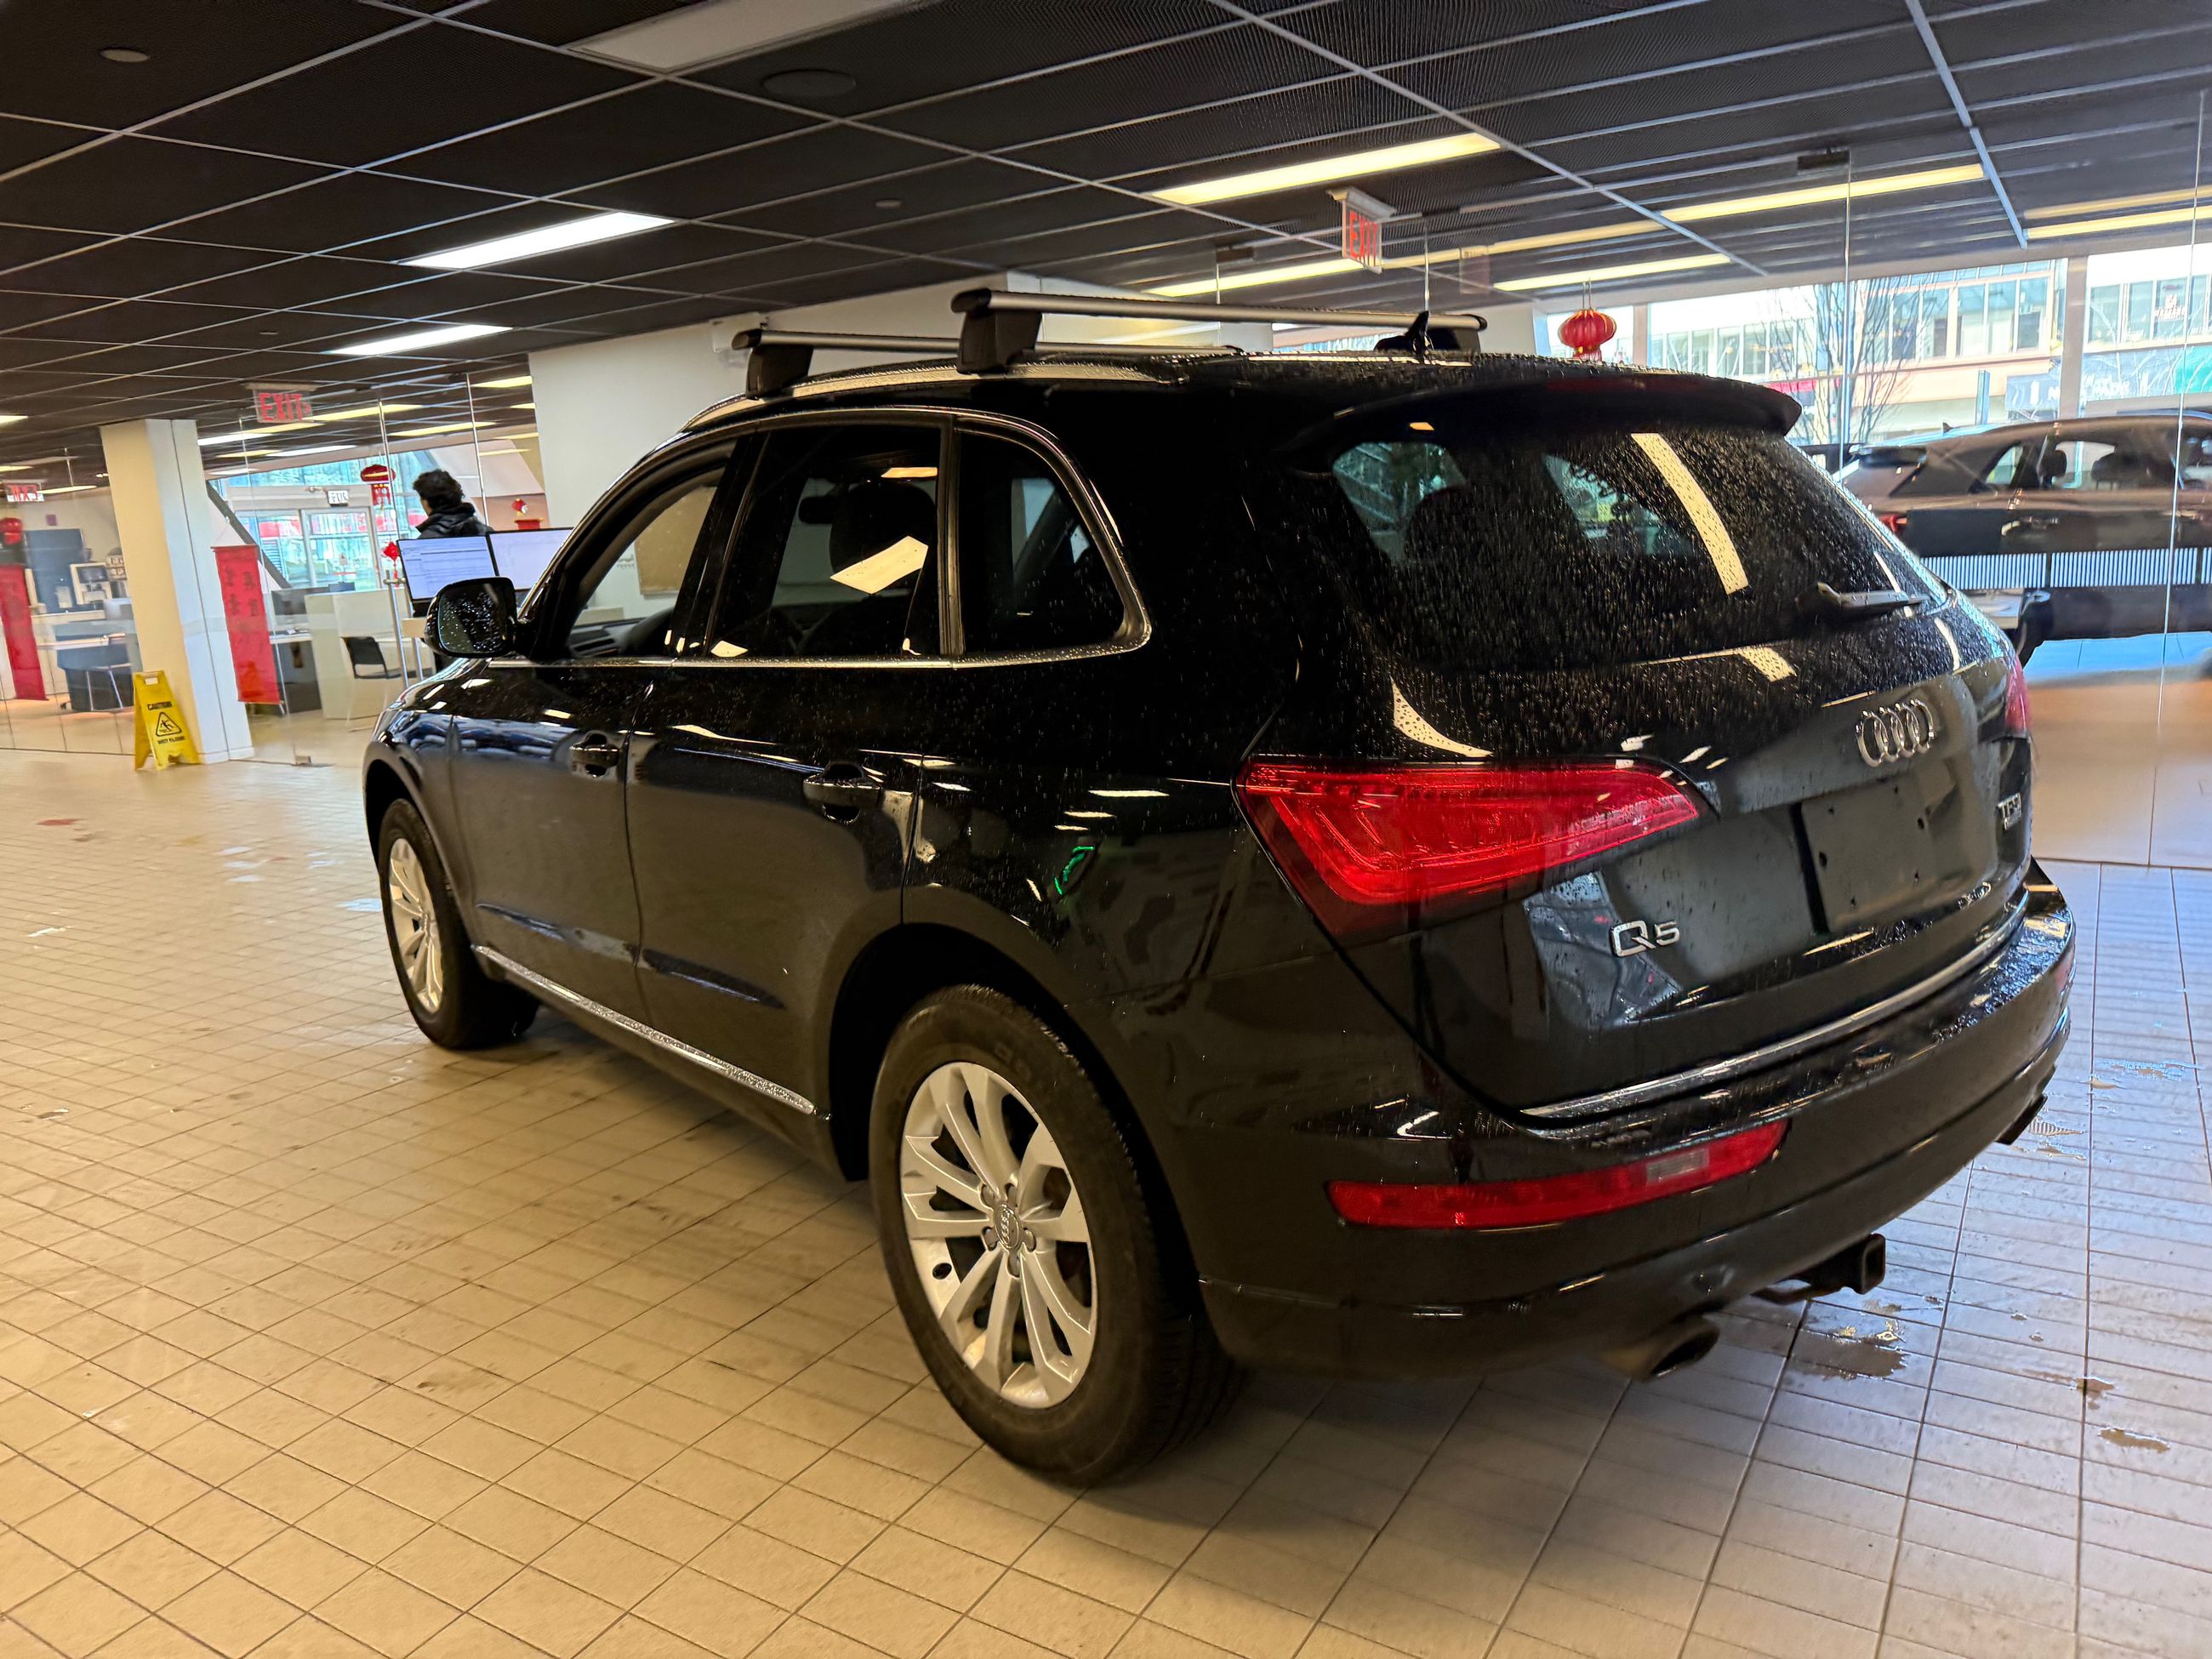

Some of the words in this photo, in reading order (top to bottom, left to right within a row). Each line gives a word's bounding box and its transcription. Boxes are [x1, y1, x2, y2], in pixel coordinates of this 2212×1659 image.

[1349, 210, 1379, 267] EXIT
[259, 392, 302, 421] EXIT
[1611, 920, 1680, 957] Q5
